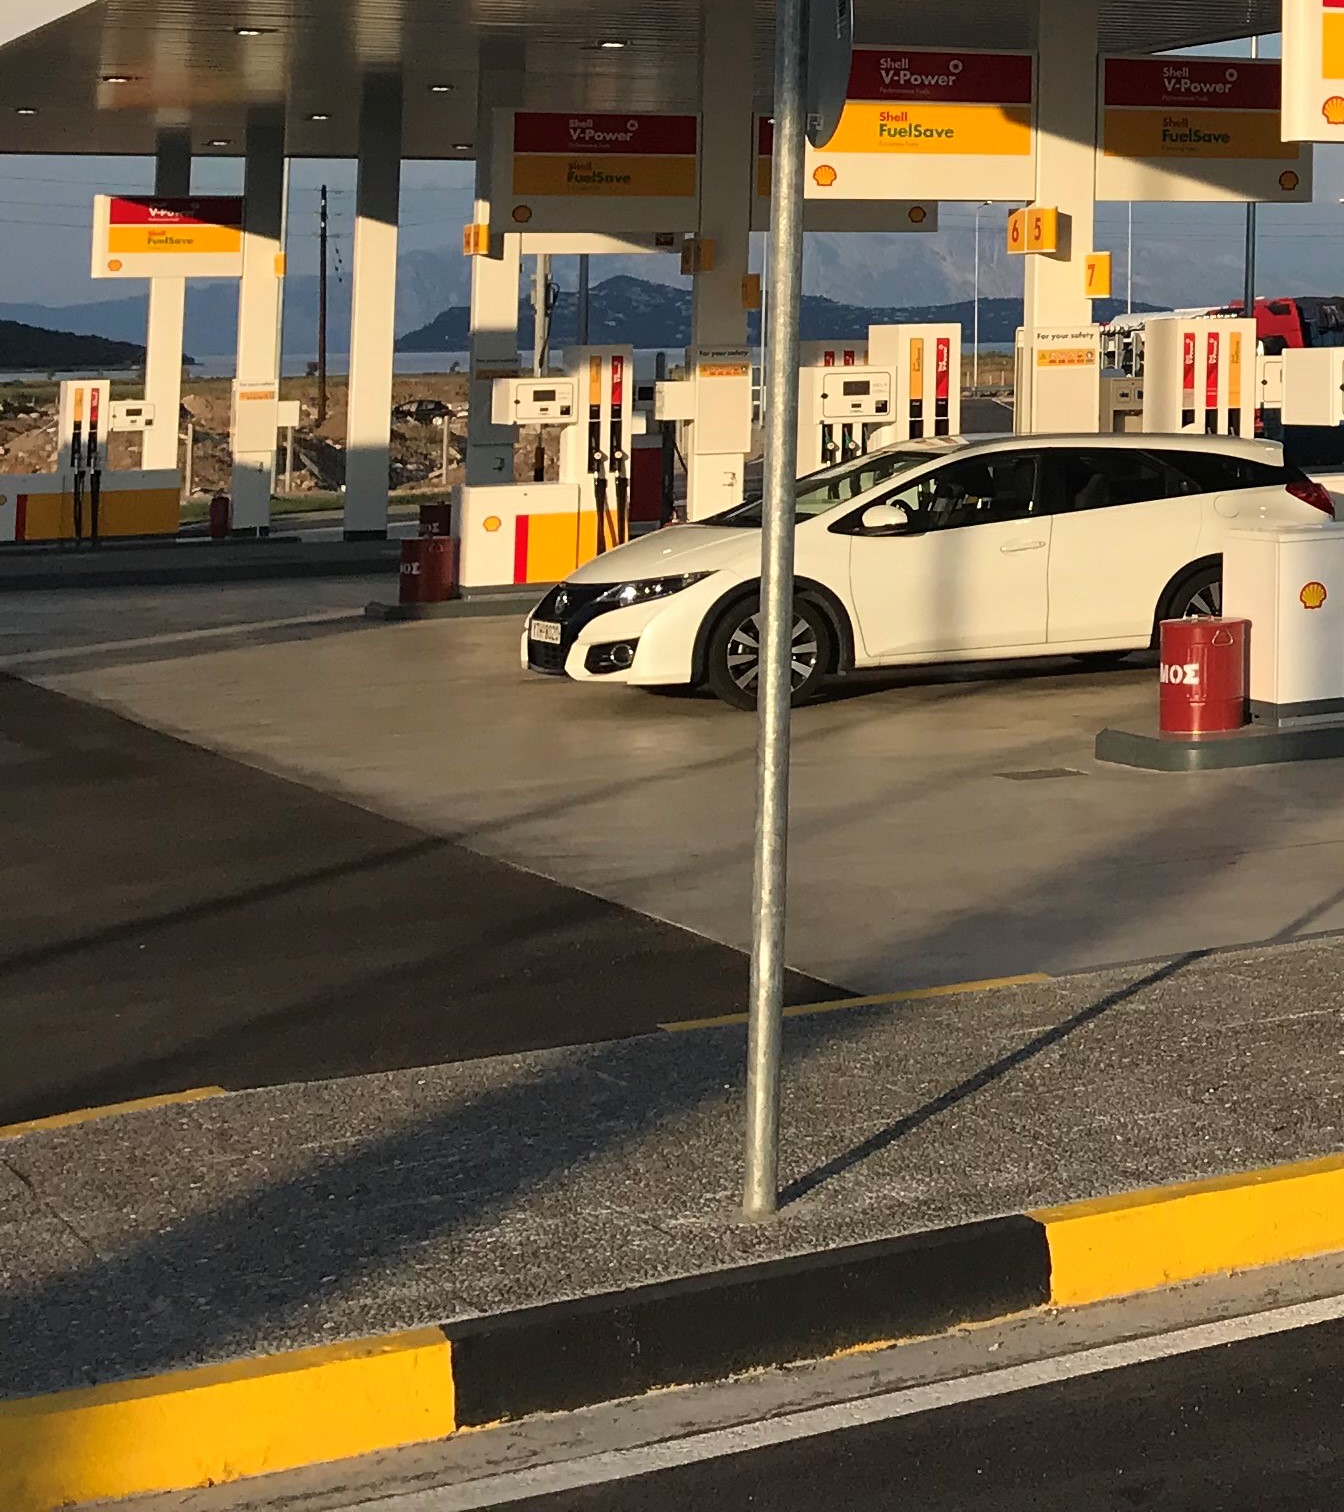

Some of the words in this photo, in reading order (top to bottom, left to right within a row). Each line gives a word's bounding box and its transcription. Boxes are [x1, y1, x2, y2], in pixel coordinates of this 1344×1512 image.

[879, 57, 909, 69] Shell
[880, 70, 956, 86] V-Power
[1163, 66, 1189, 78] Shell
[1163, 78, 1232, 94] V-Power
[879, 111, 908, 122] Shell
[1162, 117, 1188, 128] Shell
[569, 128, 634, 141] V-Power
[879, 123, 954, 138] FuelSave
[1162, 128, 1230, 143] FuelSave
[1011, 219, 1020, 243] 6
[1034, 217, 1042, 241] 5
[1087, 264, 1096, 287] 7
[1071, 331, 1094, 340] safety
